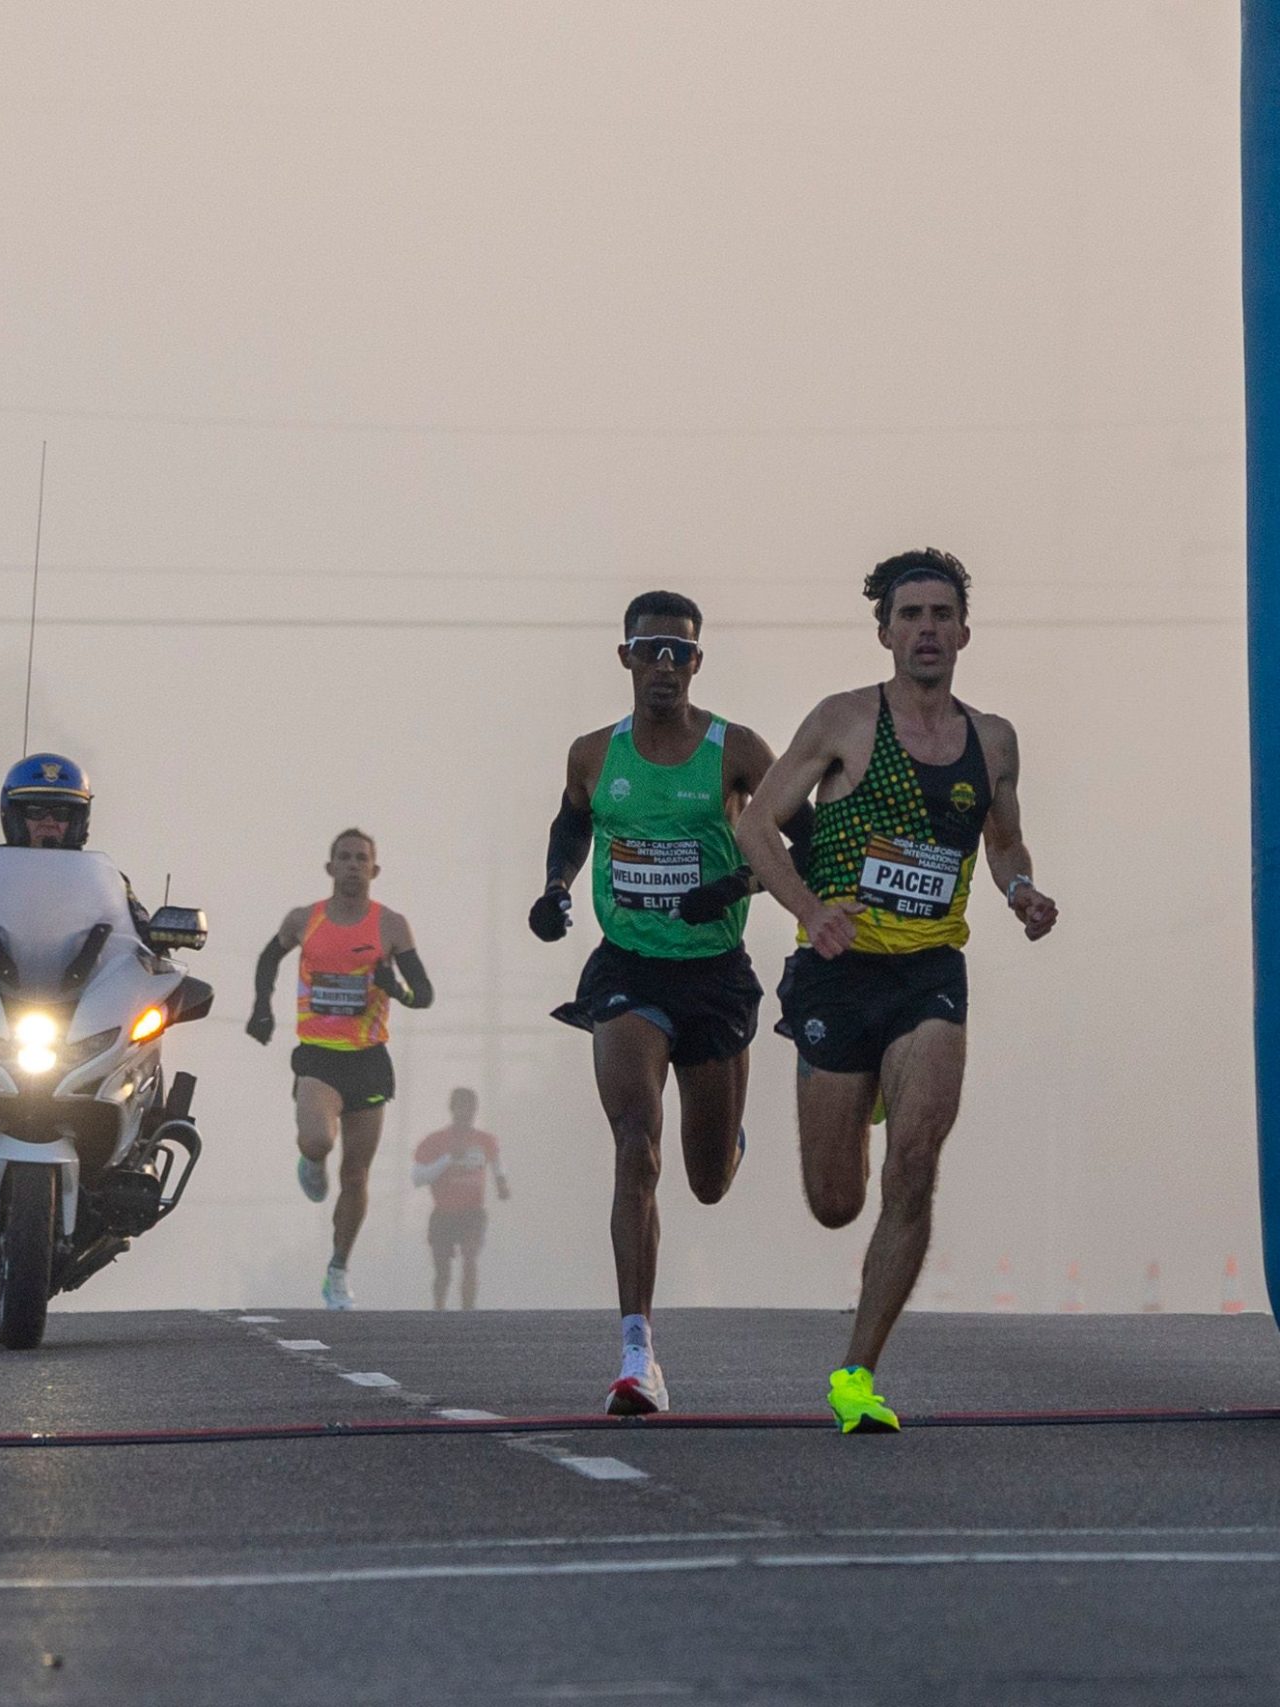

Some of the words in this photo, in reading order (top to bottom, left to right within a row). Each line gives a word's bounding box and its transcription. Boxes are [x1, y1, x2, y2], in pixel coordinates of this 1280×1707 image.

[652, 840, 699, 849] CALIFORNIA
[920, 843, 962, 857] CALIFORNIA
[637, 848, 698, 857] INTERNATIONAL
[654, 855, 699, 864] MARATHON
[903, 849, 960, 865] INTERNATIONAL
[919, 859, 959, 873] MARATHON
[613, 867, 699, 887] WELDLIBANOS
[875, 865, 945, 897] PACER
[643, 896, 682, 909] ELITE
[897, 899, 934, 916] ELITE
